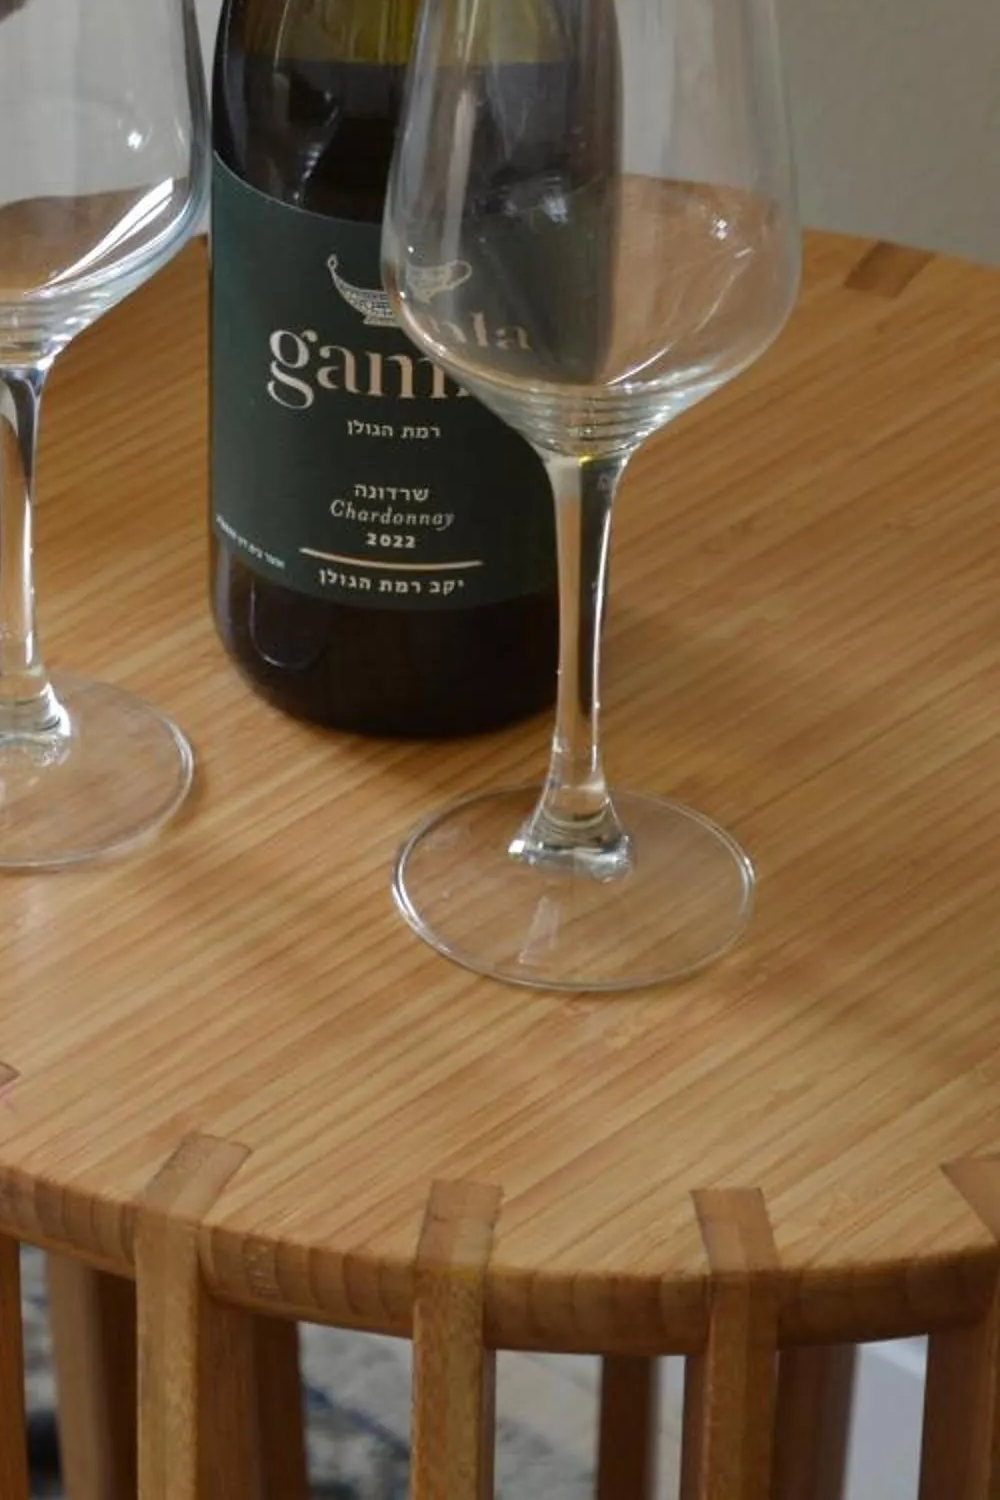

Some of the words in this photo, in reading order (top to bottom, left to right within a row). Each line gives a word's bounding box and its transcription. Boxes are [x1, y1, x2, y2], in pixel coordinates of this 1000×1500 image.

[346, 419, 394, 438] הגולן
[400, 425, 442, 439] רמת
[353, 483, 430, 503] שרדונה
[329, 499, 456, 532] Chardonnay
[365, 532, 417, 549] 2022
[317, 568, 372, 591] הגולן
[378, 579, 422, 594] רמת
[429, 579, 465, 597] יקב
